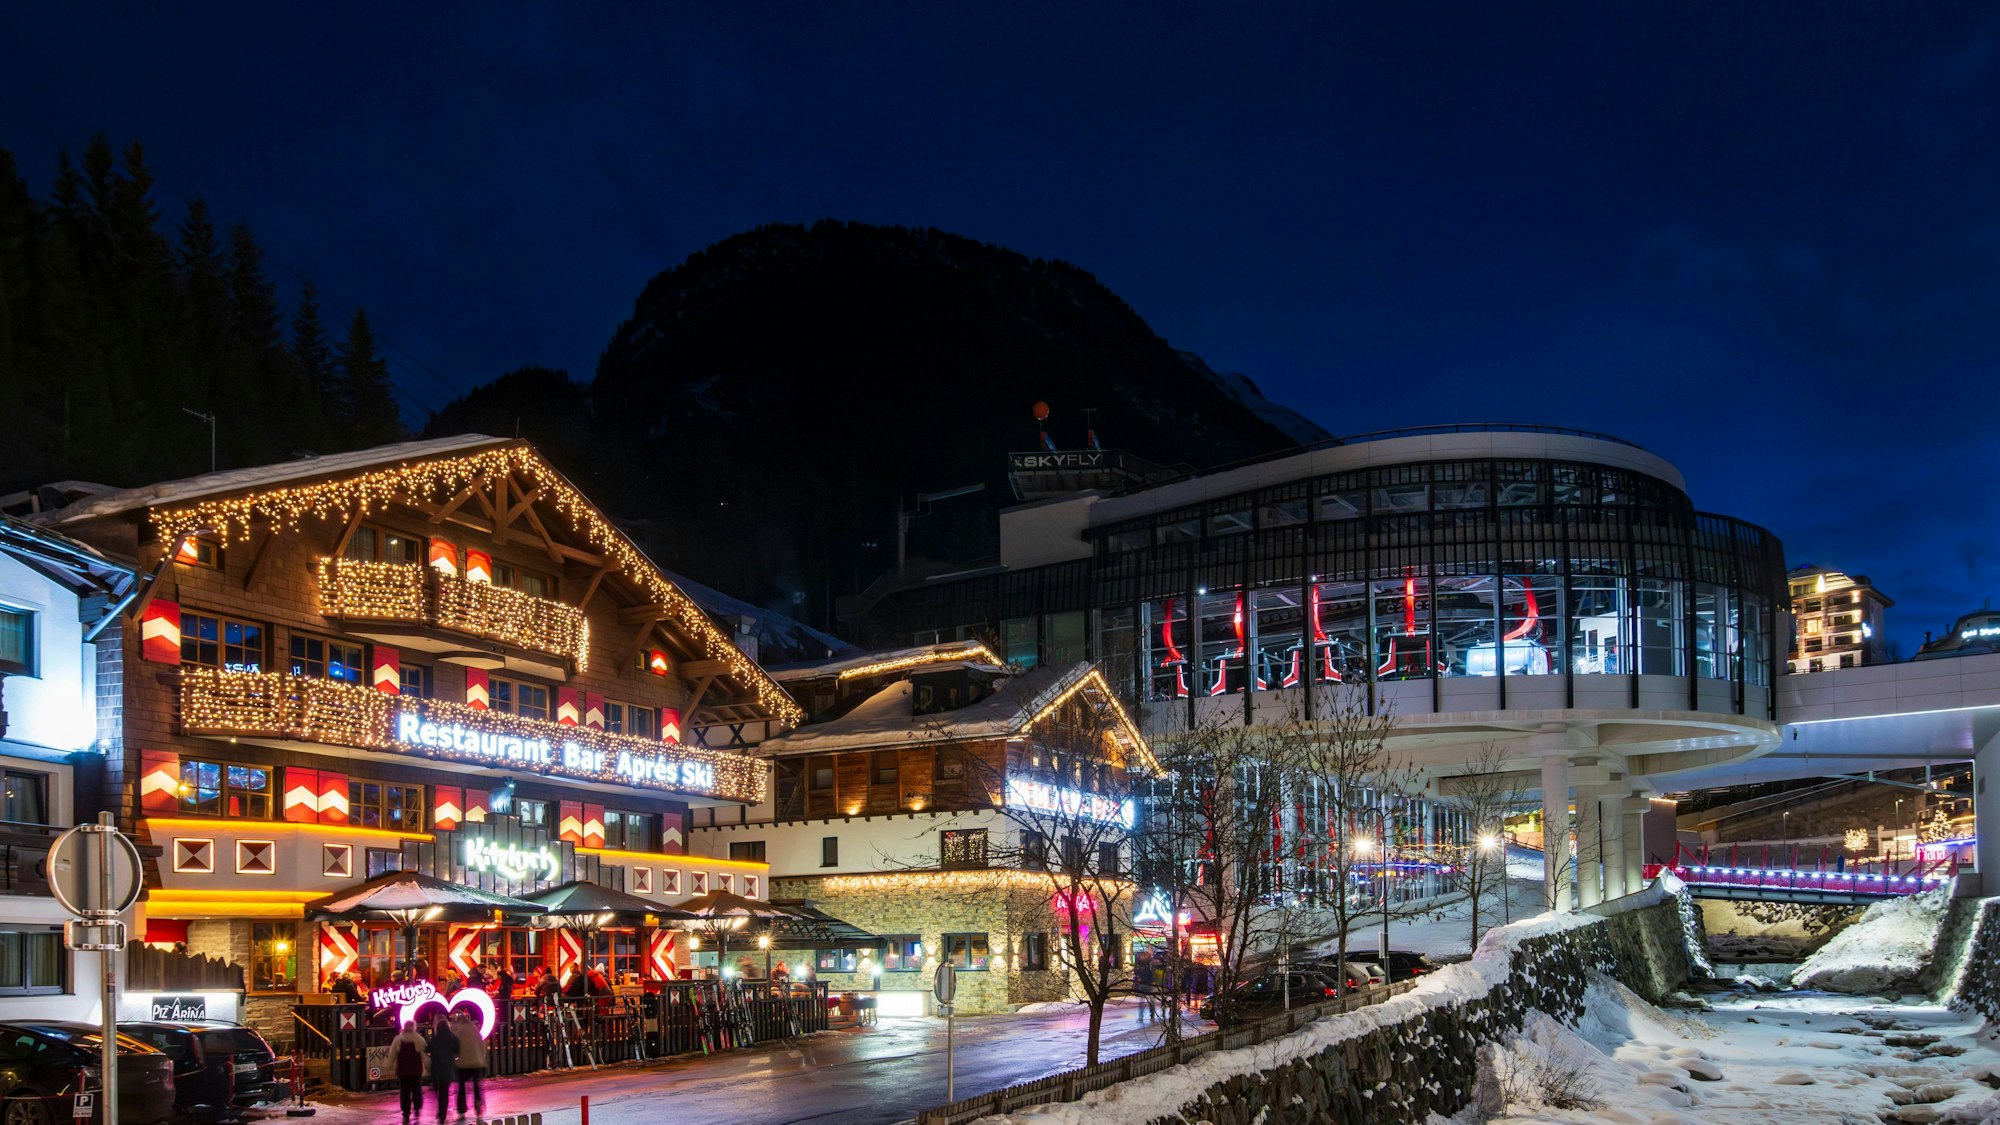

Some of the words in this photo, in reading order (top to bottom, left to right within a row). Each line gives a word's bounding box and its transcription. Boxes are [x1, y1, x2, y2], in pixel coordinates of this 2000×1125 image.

[1024, 453, 1100, 467] SKYFLY
[399, 714, 551, 764] Restaurant
[564, 743, 604, 771] Bar
[682, 762, 714, 788] Ski
[466, 838, 559, 880] Kitzloch
[372, 979, 436, 1008] Kitzloch
[80, 1095, 89, 1106] P
